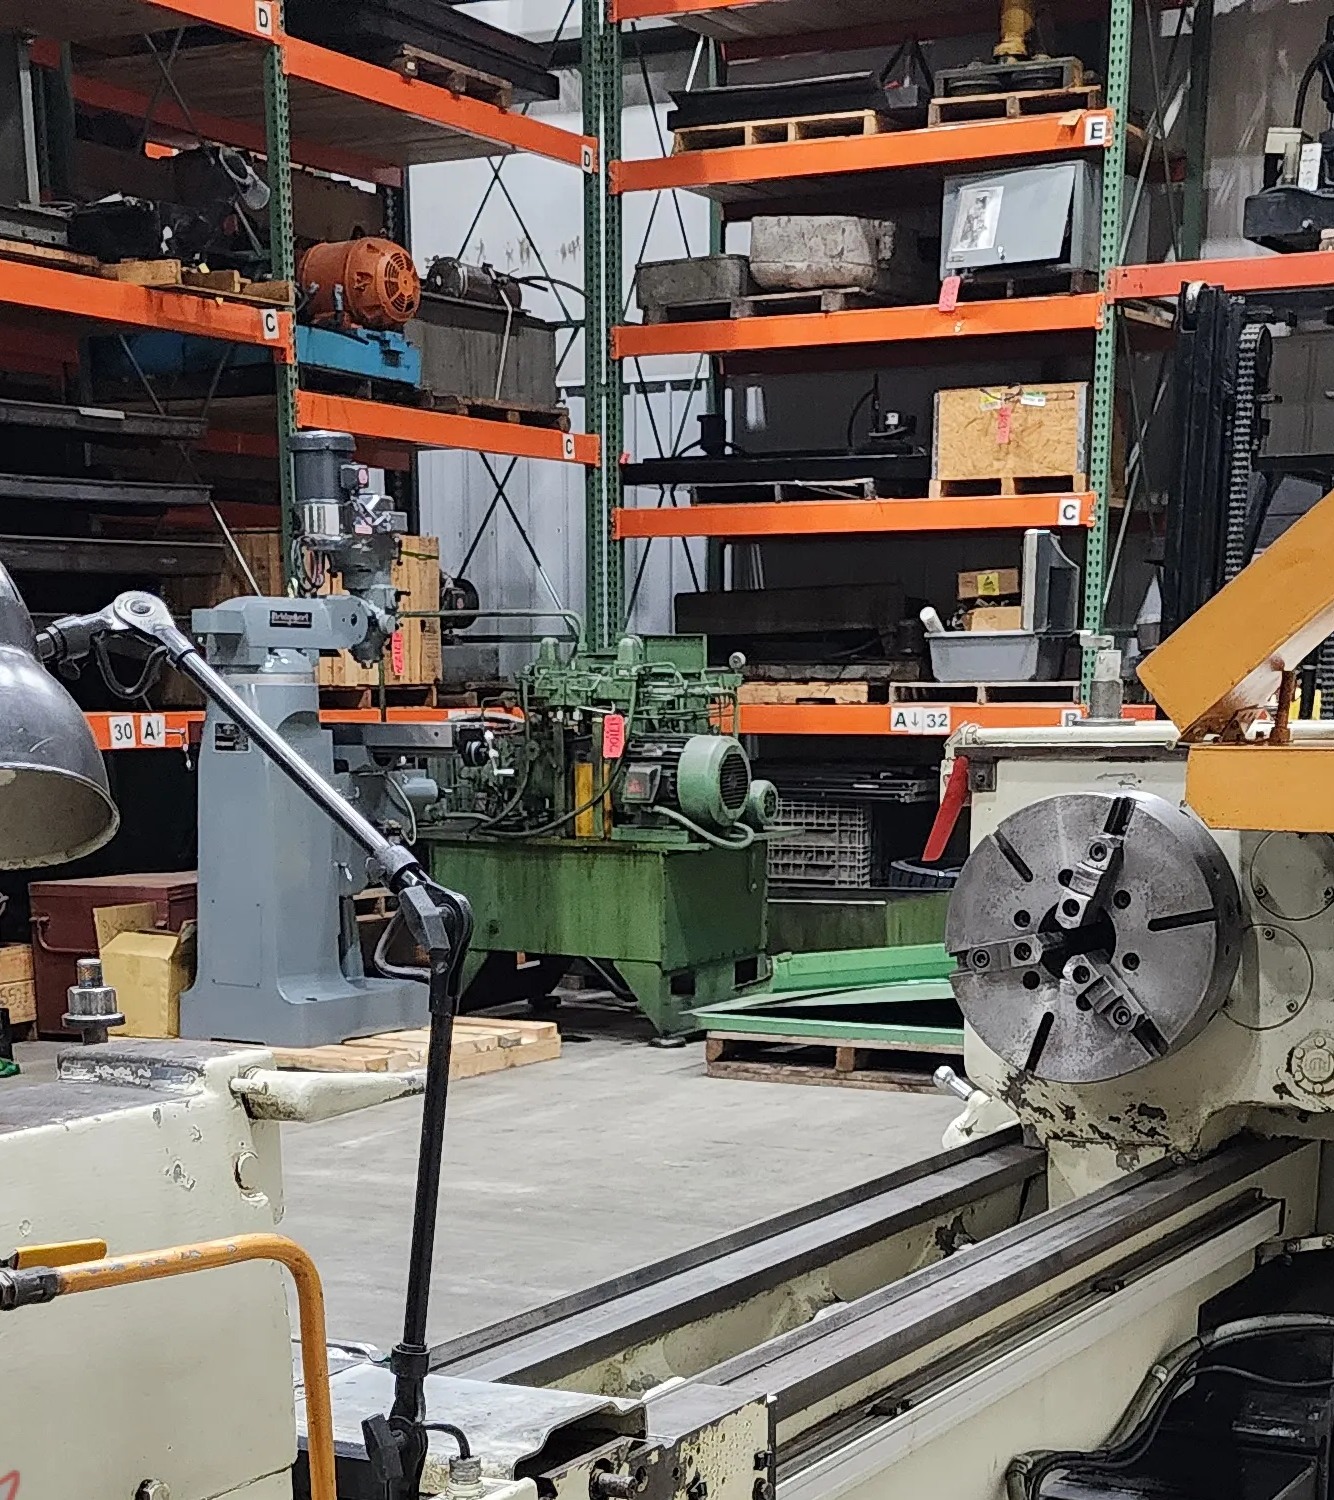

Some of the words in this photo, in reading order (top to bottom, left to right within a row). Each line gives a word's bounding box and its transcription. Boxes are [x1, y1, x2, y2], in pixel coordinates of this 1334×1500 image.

[259, 7, 269, 28] D
[1090, 121, 1104, 140] E
[583, 150, 591, 168] D
[265, 313, 276, 332] C
[565, 438, 573, 455] C
[1063, 504, 1076, 520] C
[894, 712, 907, 728] A
[926, 713, 948, 728] 32
[114, 722, 133, 741] 30
[143, 721, 157, 741] A
